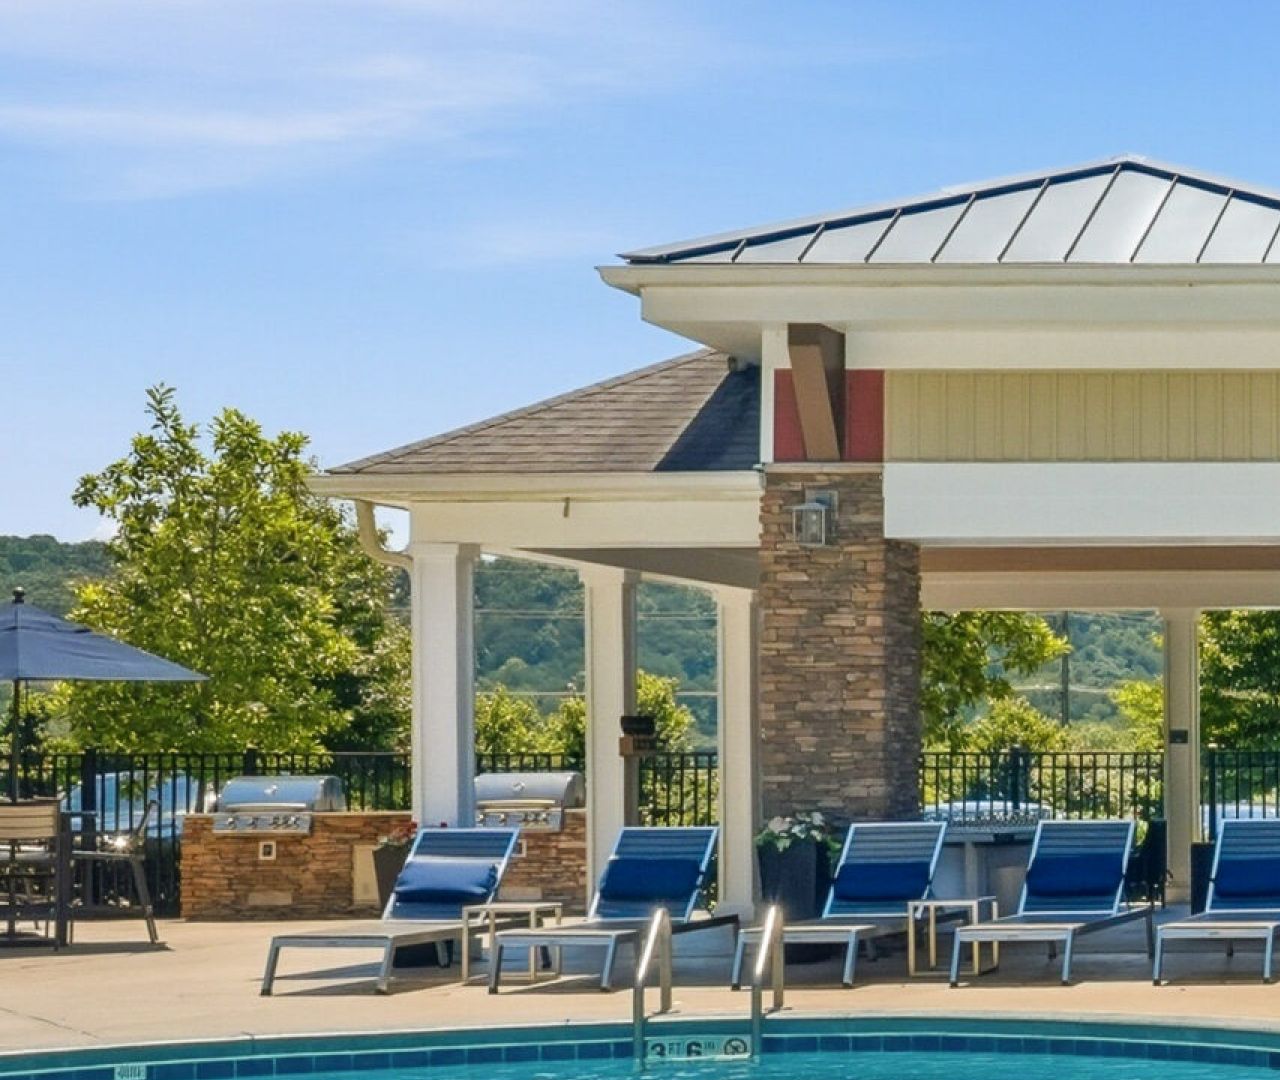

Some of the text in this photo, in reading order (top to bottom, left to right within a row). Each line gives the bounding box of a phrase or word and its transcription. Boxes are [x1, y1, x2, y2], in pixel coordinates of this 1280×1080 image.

[651, 1042, 666, 1057] 3
[668, 1042, 681, 1055] FT
[687, 1041, 703, 1057] 6
